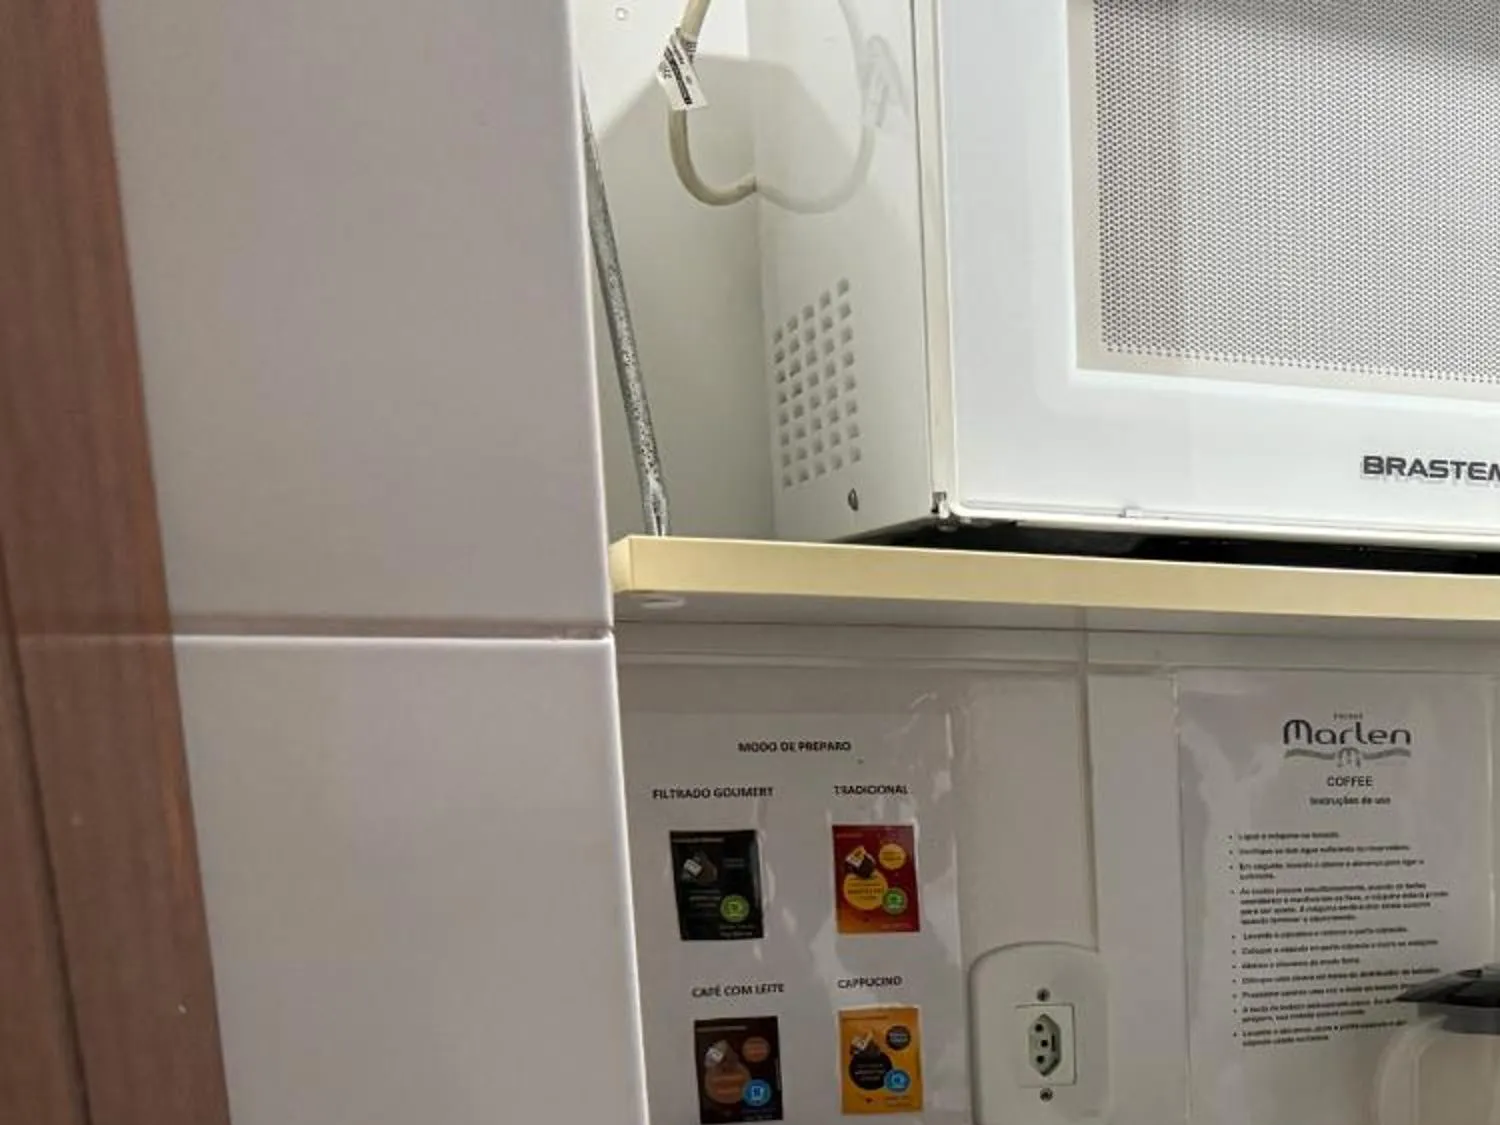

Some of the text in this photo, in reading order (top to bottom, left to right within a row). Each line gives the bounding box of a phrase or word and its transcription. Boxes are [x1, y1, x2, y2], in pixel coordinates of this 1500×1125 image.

[1282, 718, 1412, 746] Marlen
[737, 740, 852, 752] MODO DE PREPARO
[1326, 775, 1374, 787] COFFEE
[652, 787, 711, 800] FILTRADO
[837, 976, 903, 989] CAPPUCINO
[724, 986, 754, 997] COM
[755, 983, 785, 995] LEITE
